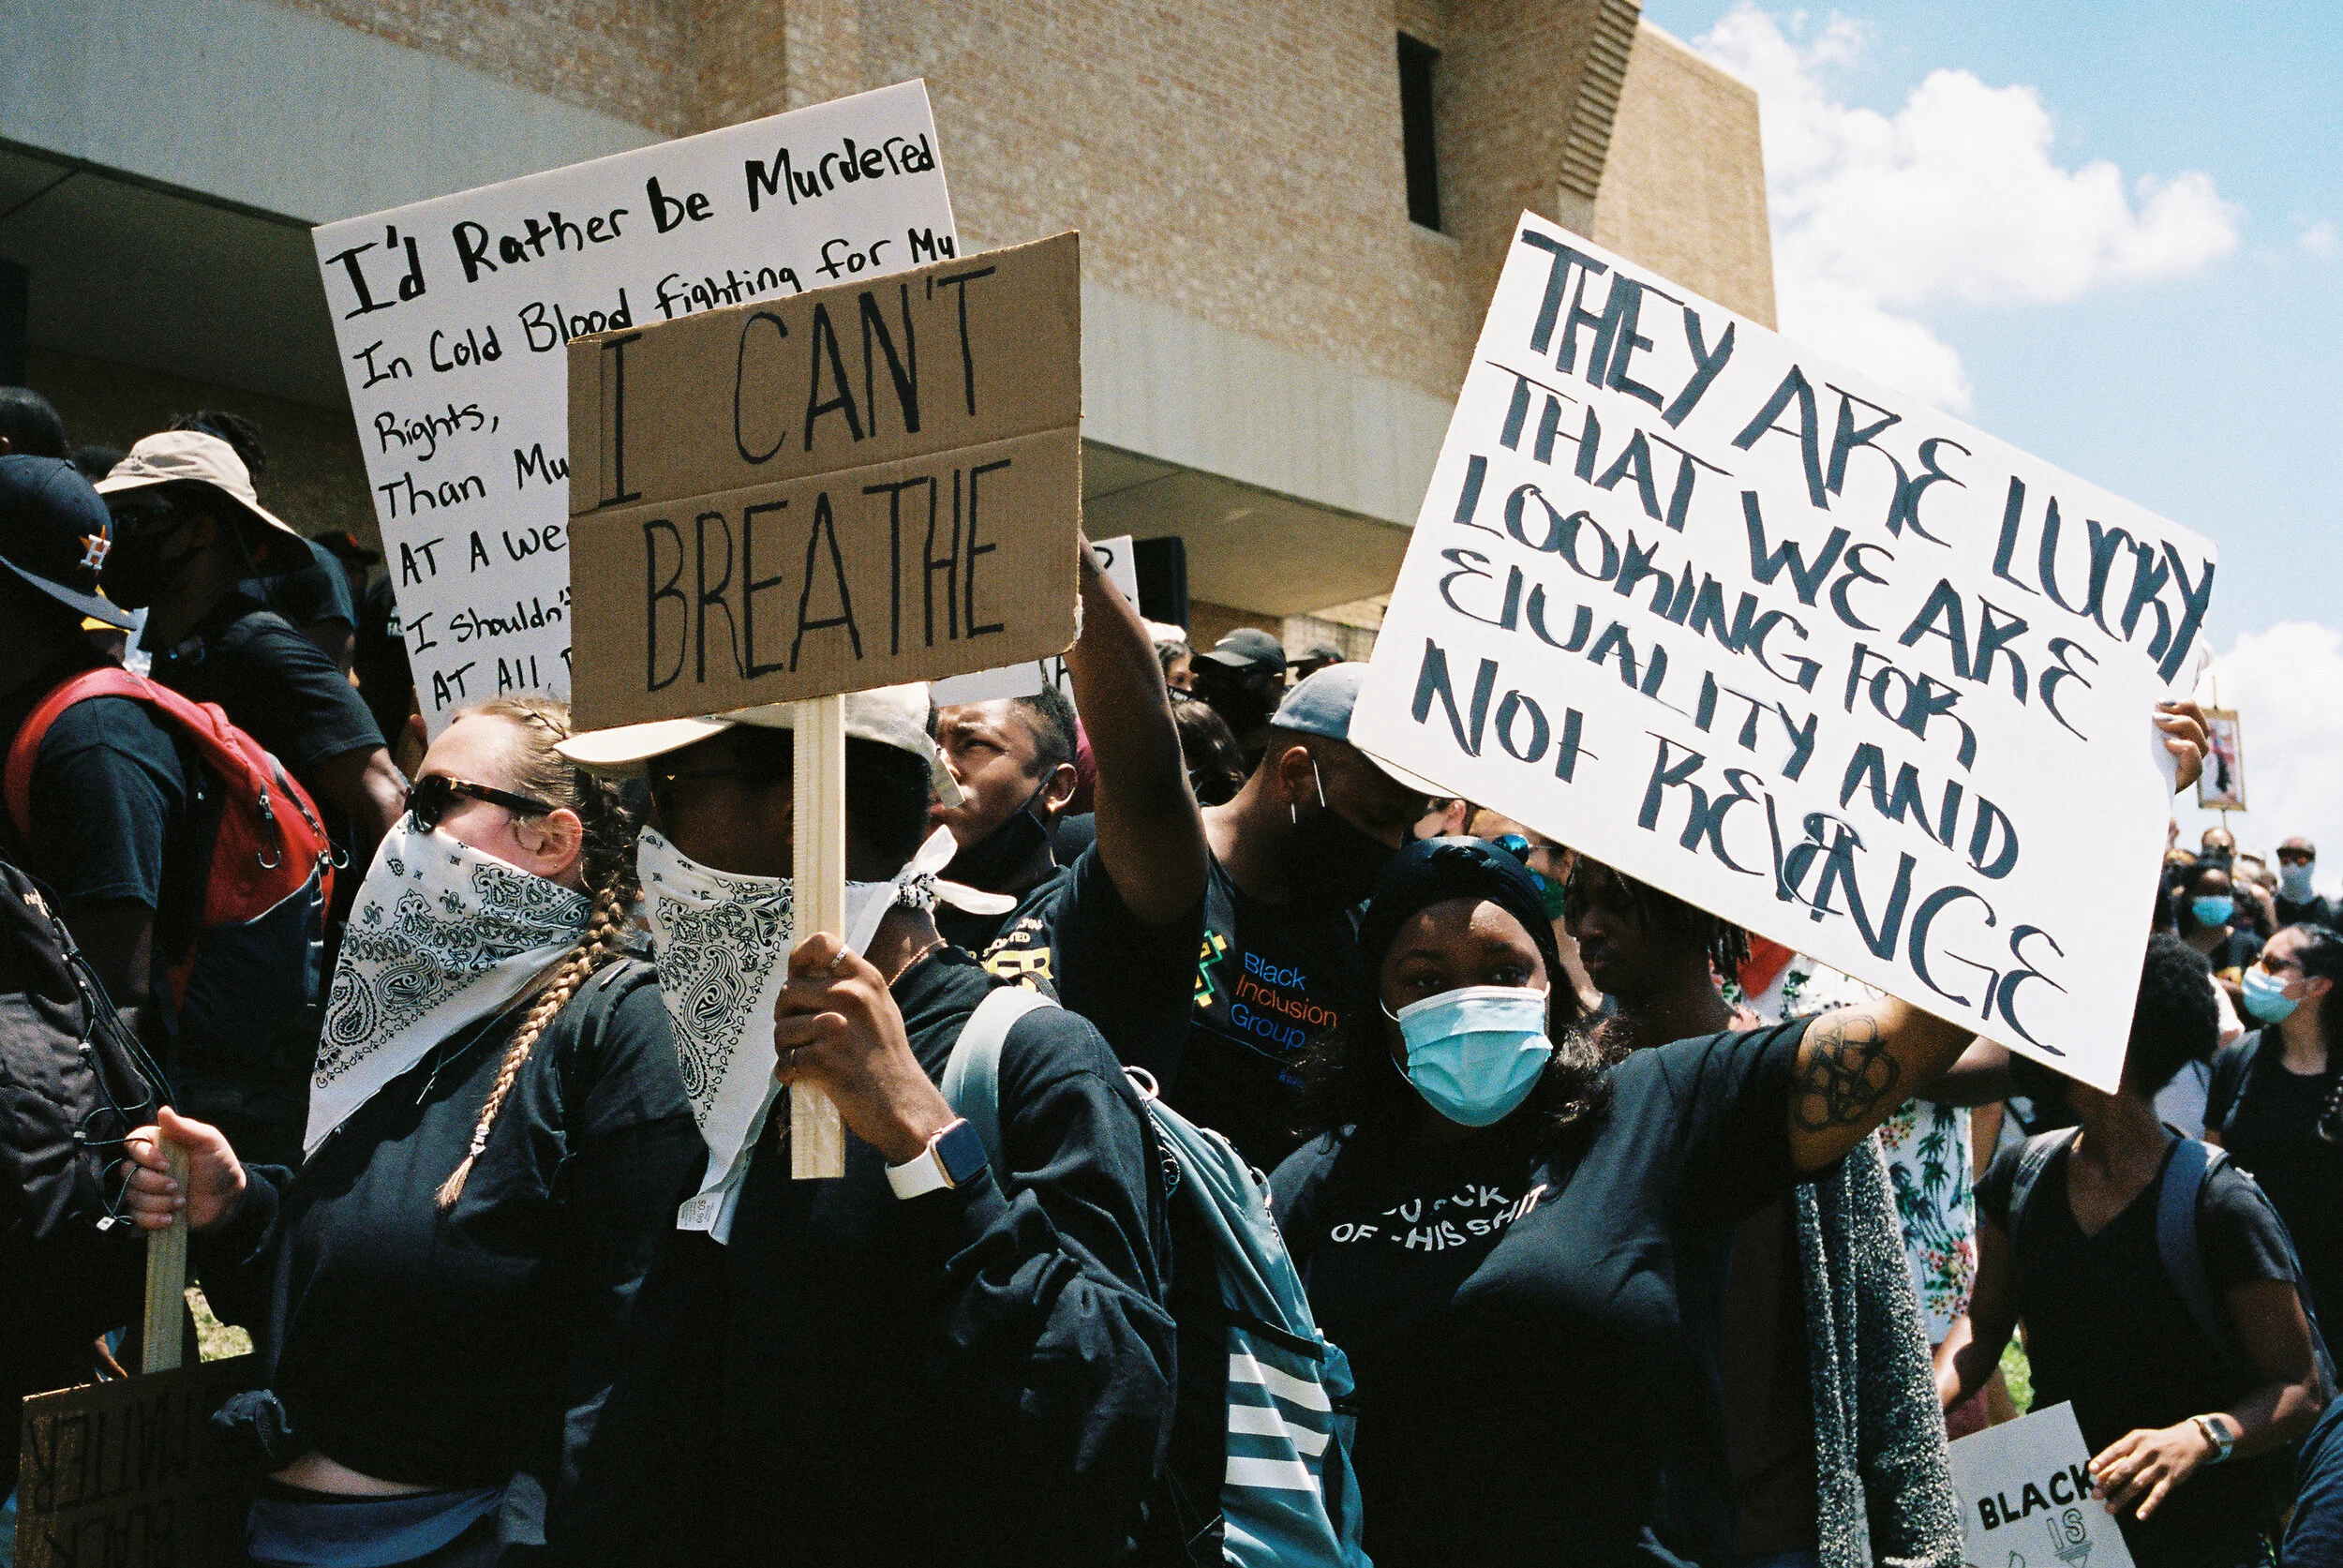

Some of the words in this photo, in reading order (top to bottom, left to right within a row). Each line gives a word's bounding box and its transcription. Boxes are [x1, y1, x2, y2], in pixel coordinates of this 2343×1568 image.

[325, 225, 425, 320] I'd
[452, 211, 629, 283] Rather
[647, 176, 713, 233] be
[745, 133, 935, 212] Murdered
[352, 340, 412, 389] In
[430, 325, 502, 372] Cold
[518, 287, 633, 352] Blood
[816, 239, 891, 279] for
[908, 228, 956, 263] My
[599, 333, 642, 507] I
[735, 266, 995, 464] CAN'T
[374, 404, 499, 461] Rights,
[1521, 229, 1735, 428] THEY
[1730, 365, 1971, 546] ARE
[1992, 475, 2216, 687] LUCKY
[378, 471, 485, 519] Than
[400, 538, 444, 587] AT
[470, 530, 490, 573] A
[644, 458, 1012, 692] BREATHE
[1486, 360, 1734, 532] THAT
[1741, 489, 1894, 631] WE
[1898, 578, 2098, 740] ARE
[406, 611, 437, 654] I
[1454, 455, 1823, 694] LOOKING
[1843, 643, 1977, 772] FOR
[432, 661, 475, 710] AT
[1840, 742, 2019, 879] AND
[1235, 974, 1336, 1028] Inclusion
[1246, 951, 1306, 991] Black
[1231, 1003, 1306, 1050] Group
[1331, 1223, 1379, 1243] OF
[1391, 1220, 1467, 1251] HIS
[1466, 1184, 1547, 1235] SHIT
[1977, 1459, 2097, 1531] BLACK
[2047, 1507, 2086, 1550] IS
